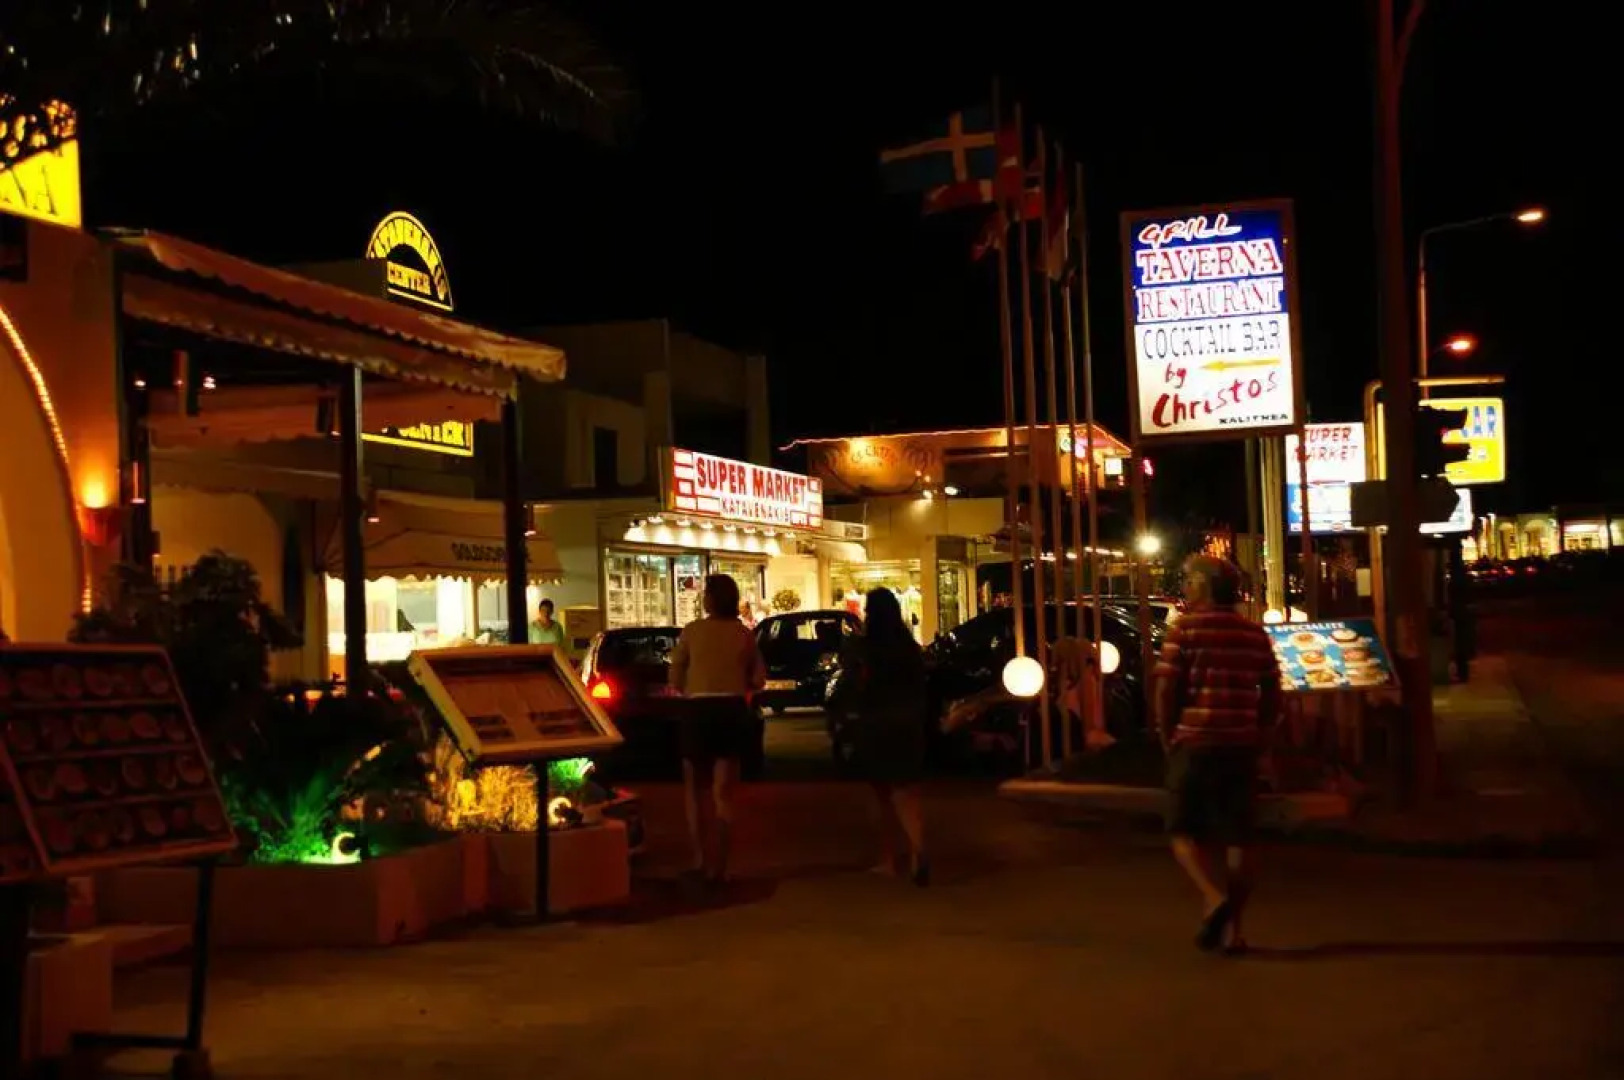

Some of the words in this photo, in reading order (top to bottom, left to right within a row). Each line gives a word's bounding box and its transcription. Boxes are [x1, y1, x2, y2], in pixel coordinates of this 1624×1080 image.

[1139, 214, 1242, 248] GRILL
[1137, 240, 1283, 283] TAVERNA
[1137, 279, 1282, 321] RESTAURANT
[1143, 323, 1236, 359] COCKTAIL
[1242, 319, 1281, 351] BAR
[1165, 362, 1187, 389] by
[1152, 372, 1277, 427] Christos
[696, 456, 746, 495] SUPER
[752, 467, 806, 504] MARKET
